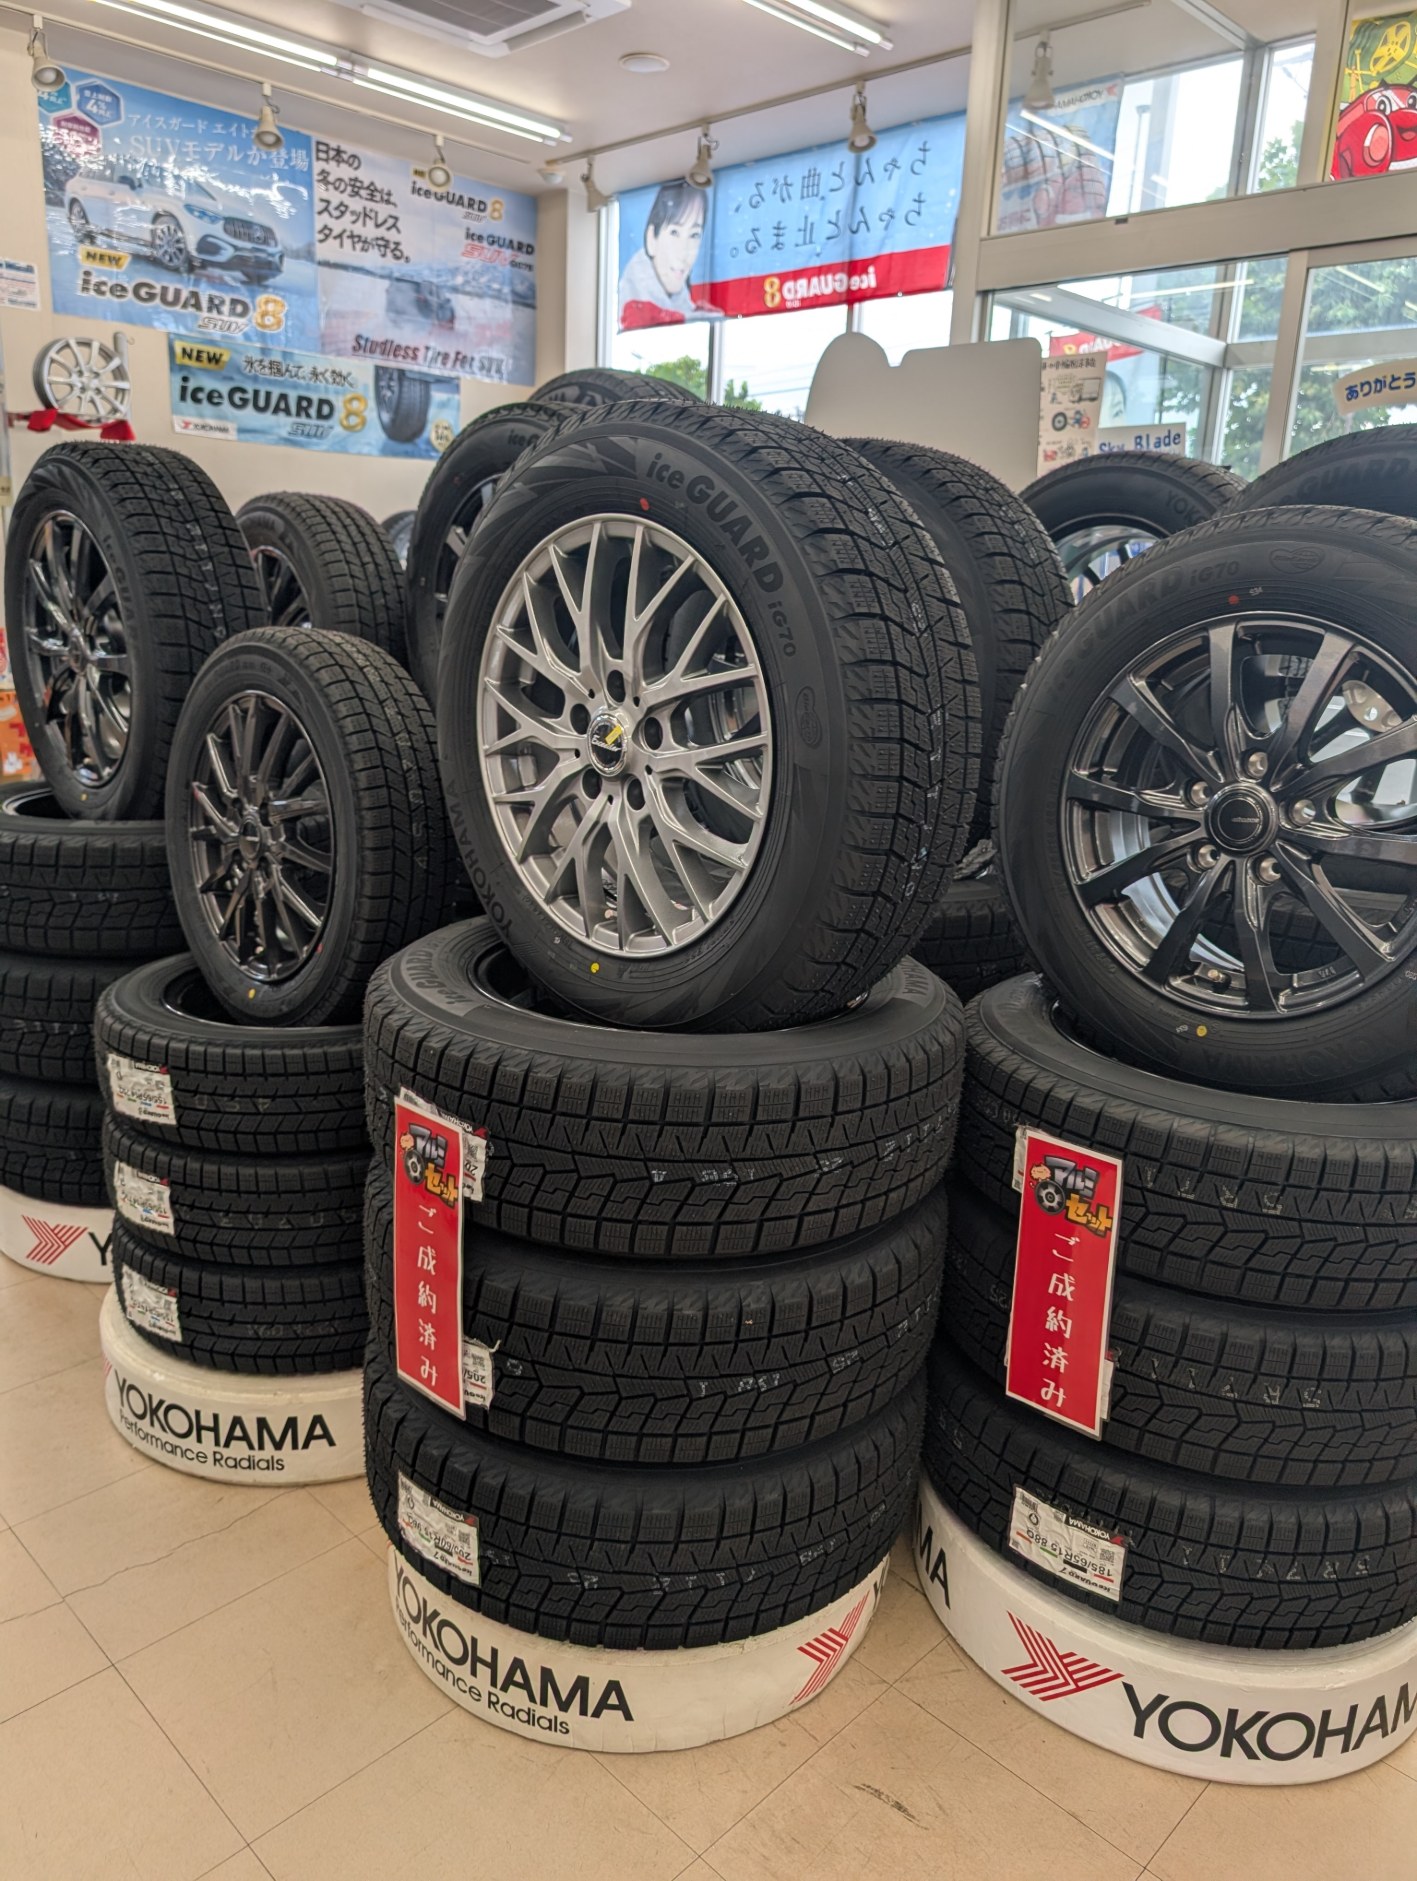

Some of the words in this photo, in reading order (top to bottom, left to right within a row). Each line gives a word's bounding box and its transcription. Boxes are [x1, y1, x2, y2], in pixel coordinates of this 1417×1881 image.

[315, 140, 362, 170] 日本の
[317, 198, 401, 234] スタッドレス
[489, 199, 504, 220] 8
[86, 251, 123, 267] NEW
[317, 224, 412, 264] タイヤが守る。
[254, 295, 286, 331] 8
[181, 347, 225, 365] NEW
[352, 334, 421, 361] Studless
[1344, 370, 1416, 402] ありがとう
[339, 392, 368, 432] 8
[1134, 429, 1181, 450] Blade
[408, 1124, 448, 1170] アルミ
[425, 1161, 459, 1210] セット
[1044, 1155, 1100, 1199] アルミ
[1065, 1193, 1114, 1238] セット
[417, 1204, 439, 1387] ご成約済み
[1040, 1232, 1081, 1408] ご成約済み
[114, 1368, 337, 1452] YOKOHAMA
[119, 1408, 209, 1464] Performance
[213, 1450, 286, 1472] Radials
[1068, 1516, 1111, 1540] YOKOHAMA
[1050, 1543, 1113, 1577] 185/65R15
[394, 1549, 635, 1722] YOKOHAMA
[487, 1690, 570, 1735] Radials
